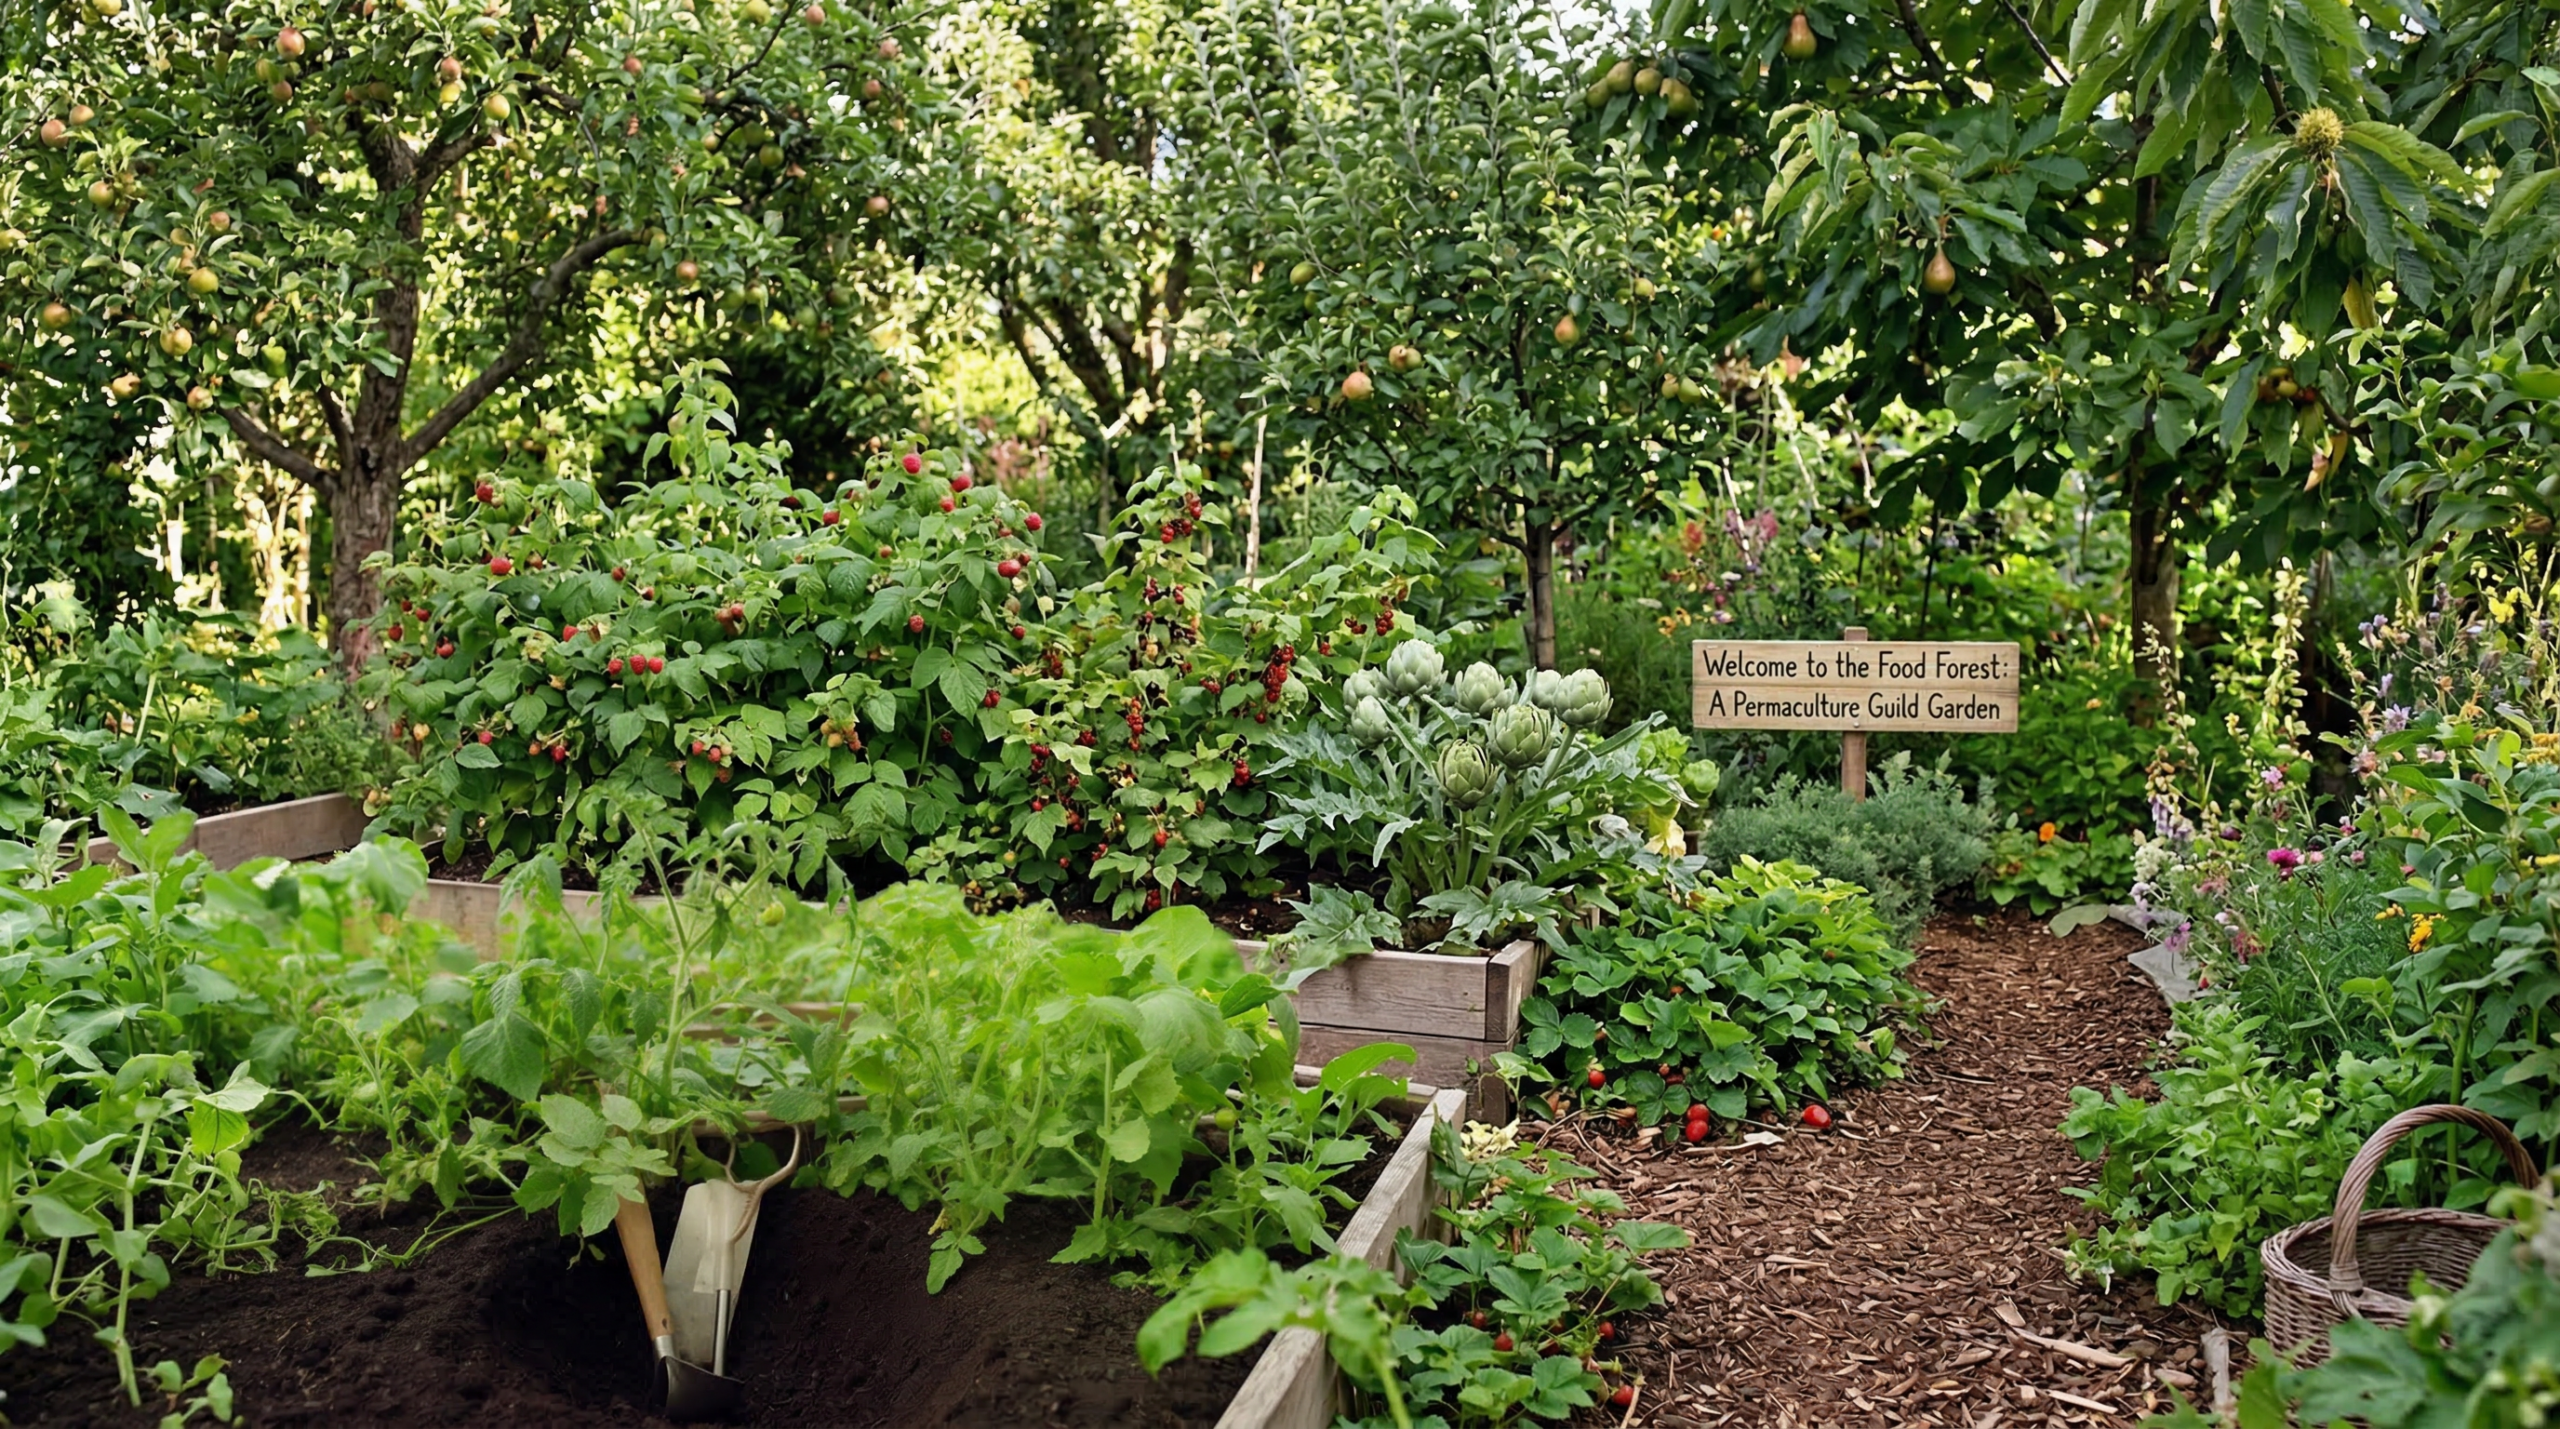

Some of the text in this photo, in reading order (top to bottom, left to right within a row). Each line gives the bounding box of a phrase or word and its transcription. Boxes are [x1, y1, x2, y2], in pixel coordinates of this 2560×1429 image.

[1703, 650, 2007, 679] Welcome to the Food Forest:
[1709, 690, 1999, 719] A Permaculture Guild Garden
